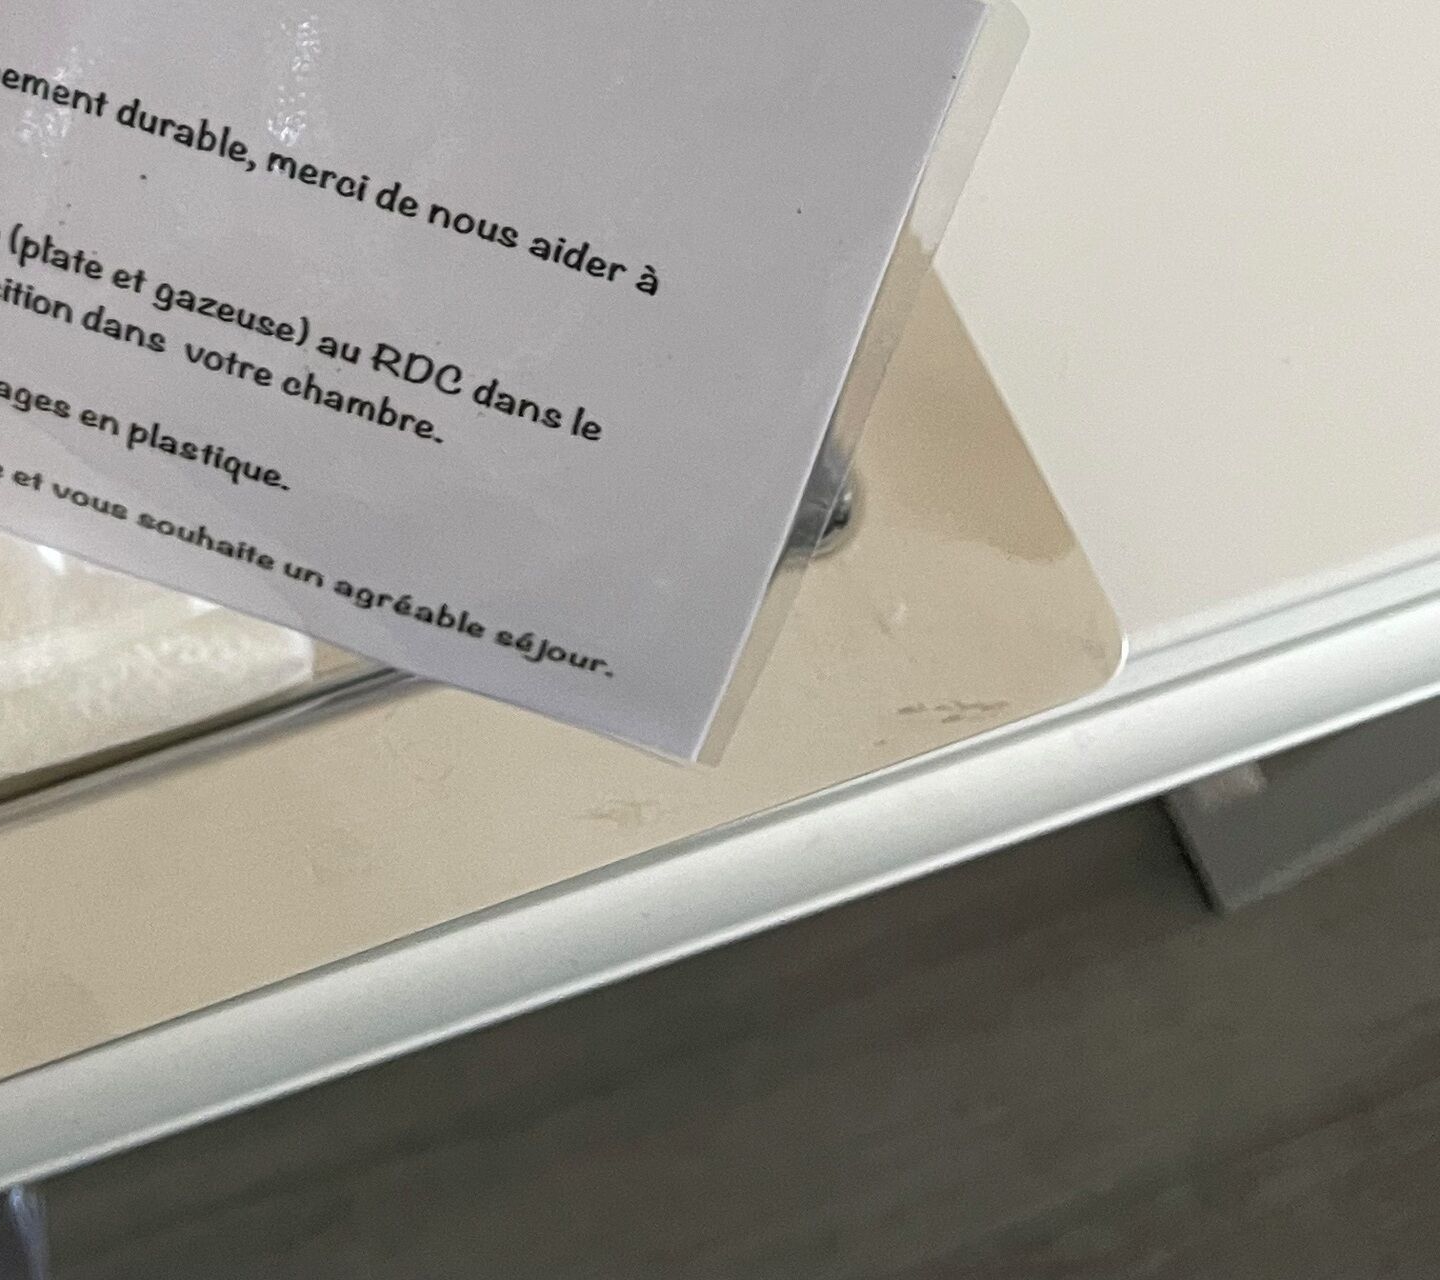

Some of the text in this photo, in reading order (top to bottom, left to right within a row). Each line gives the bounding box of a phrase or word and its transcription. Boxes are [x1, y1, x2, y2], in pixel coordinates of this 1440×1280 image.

[116, 97, 258, 173] durable,
[267, 149, 370, 203] merci
[376, 181, 419, 219] de
[427, 200, 519, 249] nous
[528, 235, 628, 285] aider
[634, 263, 660, 297] à
[8, 223, 103, 281] (plate
[111, 264, 148, 296] et
[154, 280, 310, 348] gazeuse)
[316, 334, 363, 367] au
[370, 342, 464, 396] RDC
[472, 378, 563, 430] dans
[569, 407, 603, 442] le
[81, 305, 167, 354] dans
[184, 341, 273, 388] votre
[280, 373, 445, 444] chambre.
[79, 406, 120, 437] en
[125, 417, 292, 493] plastique.
[12, 465, 43, 493] et
[52, 480, 129, 521] vous
[135, 509, 275, 572] souhaite
[282, 557, 326, 590] un
[332, 573, 486, 641] agréable
[494, 626, 615, 679] séjour.
